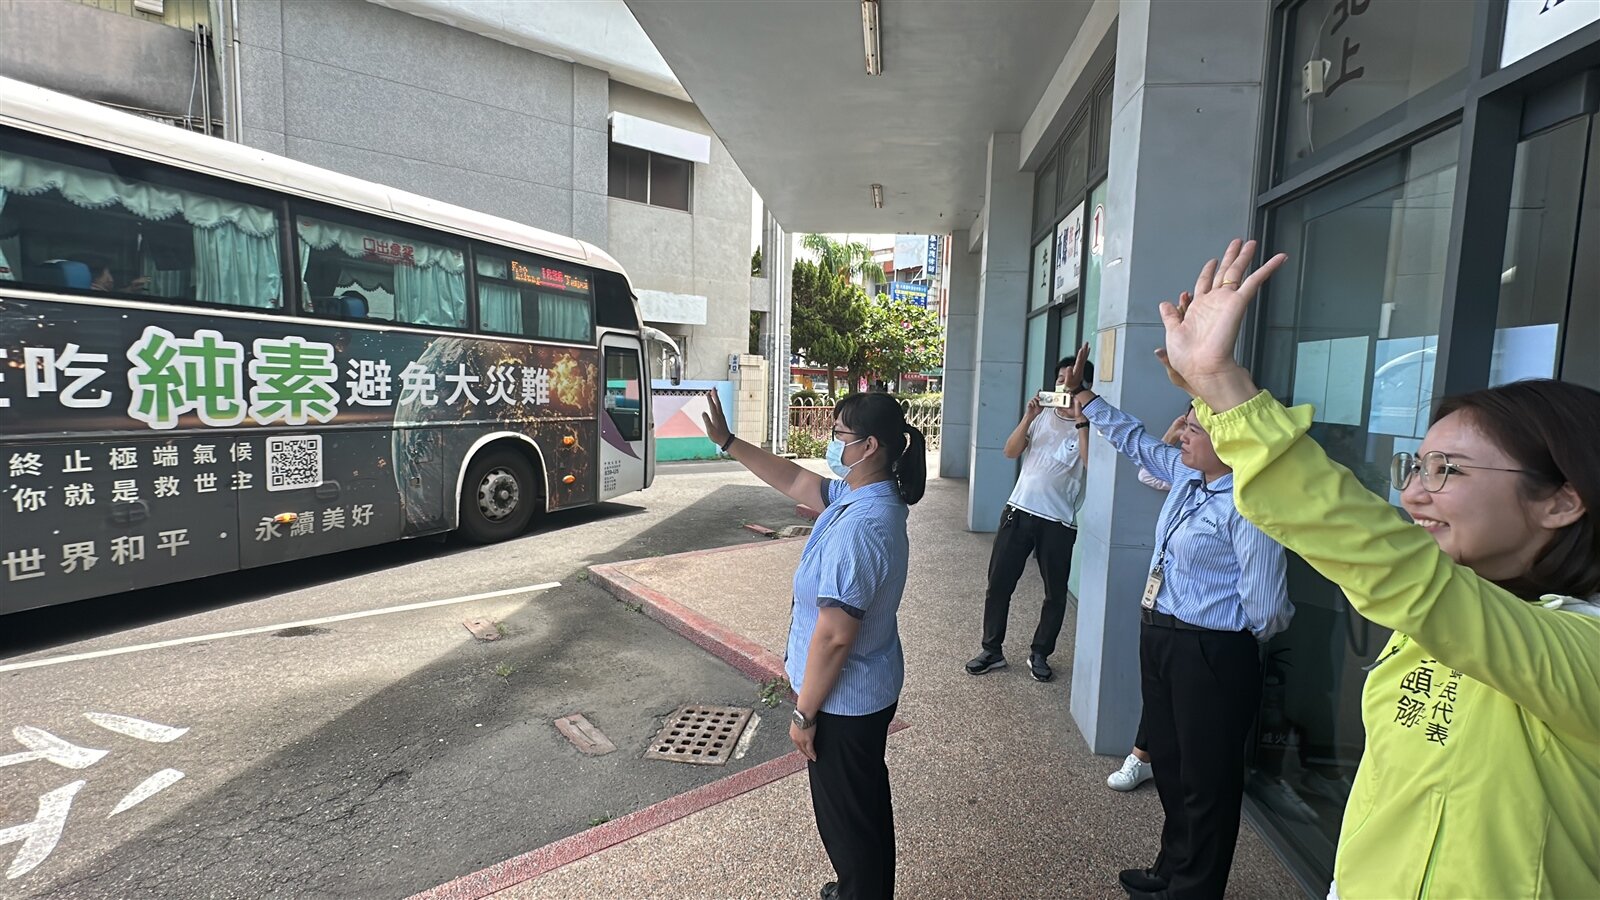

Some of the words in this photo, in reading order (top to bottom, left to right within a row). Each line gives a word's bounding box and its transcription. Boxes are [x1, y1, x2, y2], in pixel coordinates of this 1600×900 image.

[1094, 211, 1100, 249] 1
[9, 441, 253, 478] 終止極端氣候
[12, 470, 253, 513] 你就是救世主
[1394, 659, 1436, 728] 頤翎
